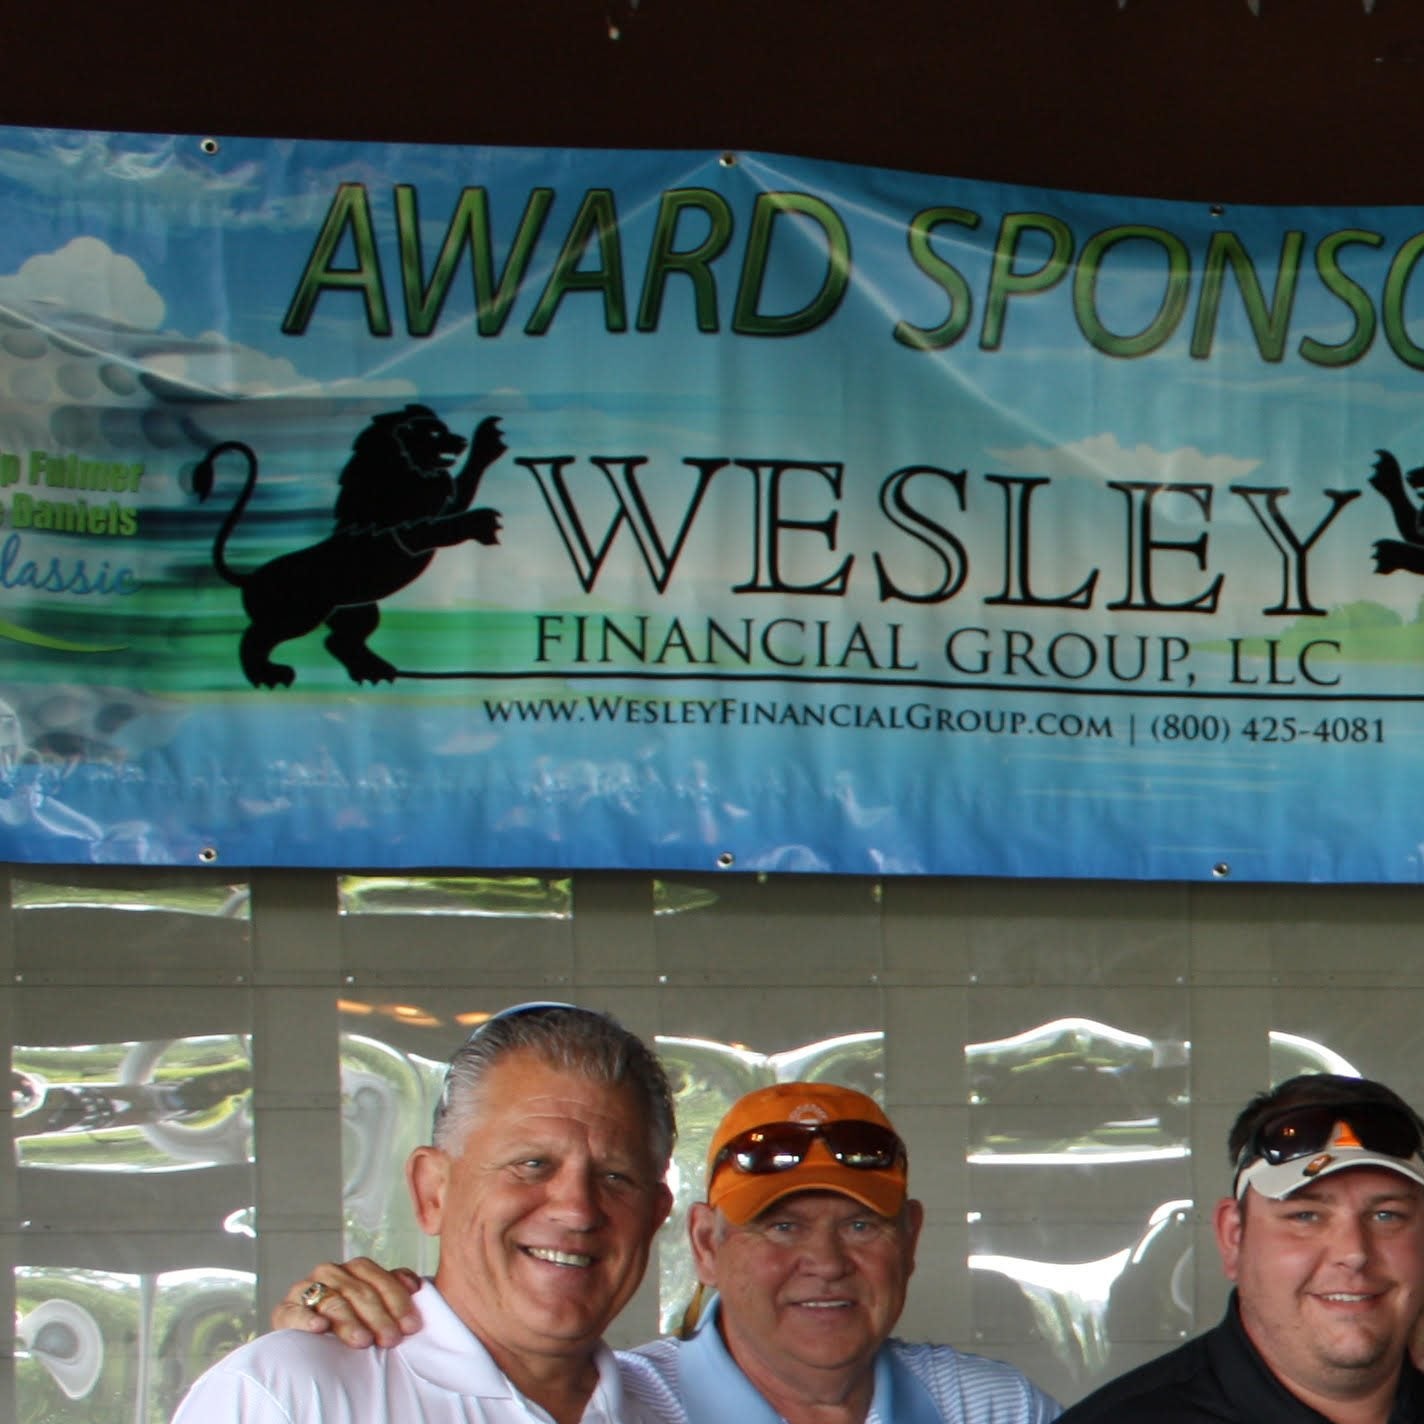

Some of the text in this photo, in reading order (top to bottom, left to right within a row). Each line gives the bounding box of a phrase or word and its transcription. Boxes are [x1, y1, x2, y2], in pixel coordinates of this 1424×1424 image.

[281, 182, 852, 338] AWARD
[29, 450, 145, 492] Fulmer
[12, 492, 137, 536] Daniels
[515, 455, 1361, 617] WESLEY
[536, 615, 1342, 687] FINANCIAL GROUP, LLC
[1150, 713, 1231, 745] (800)
[1241, 716, 1386, 744] 425-4081
